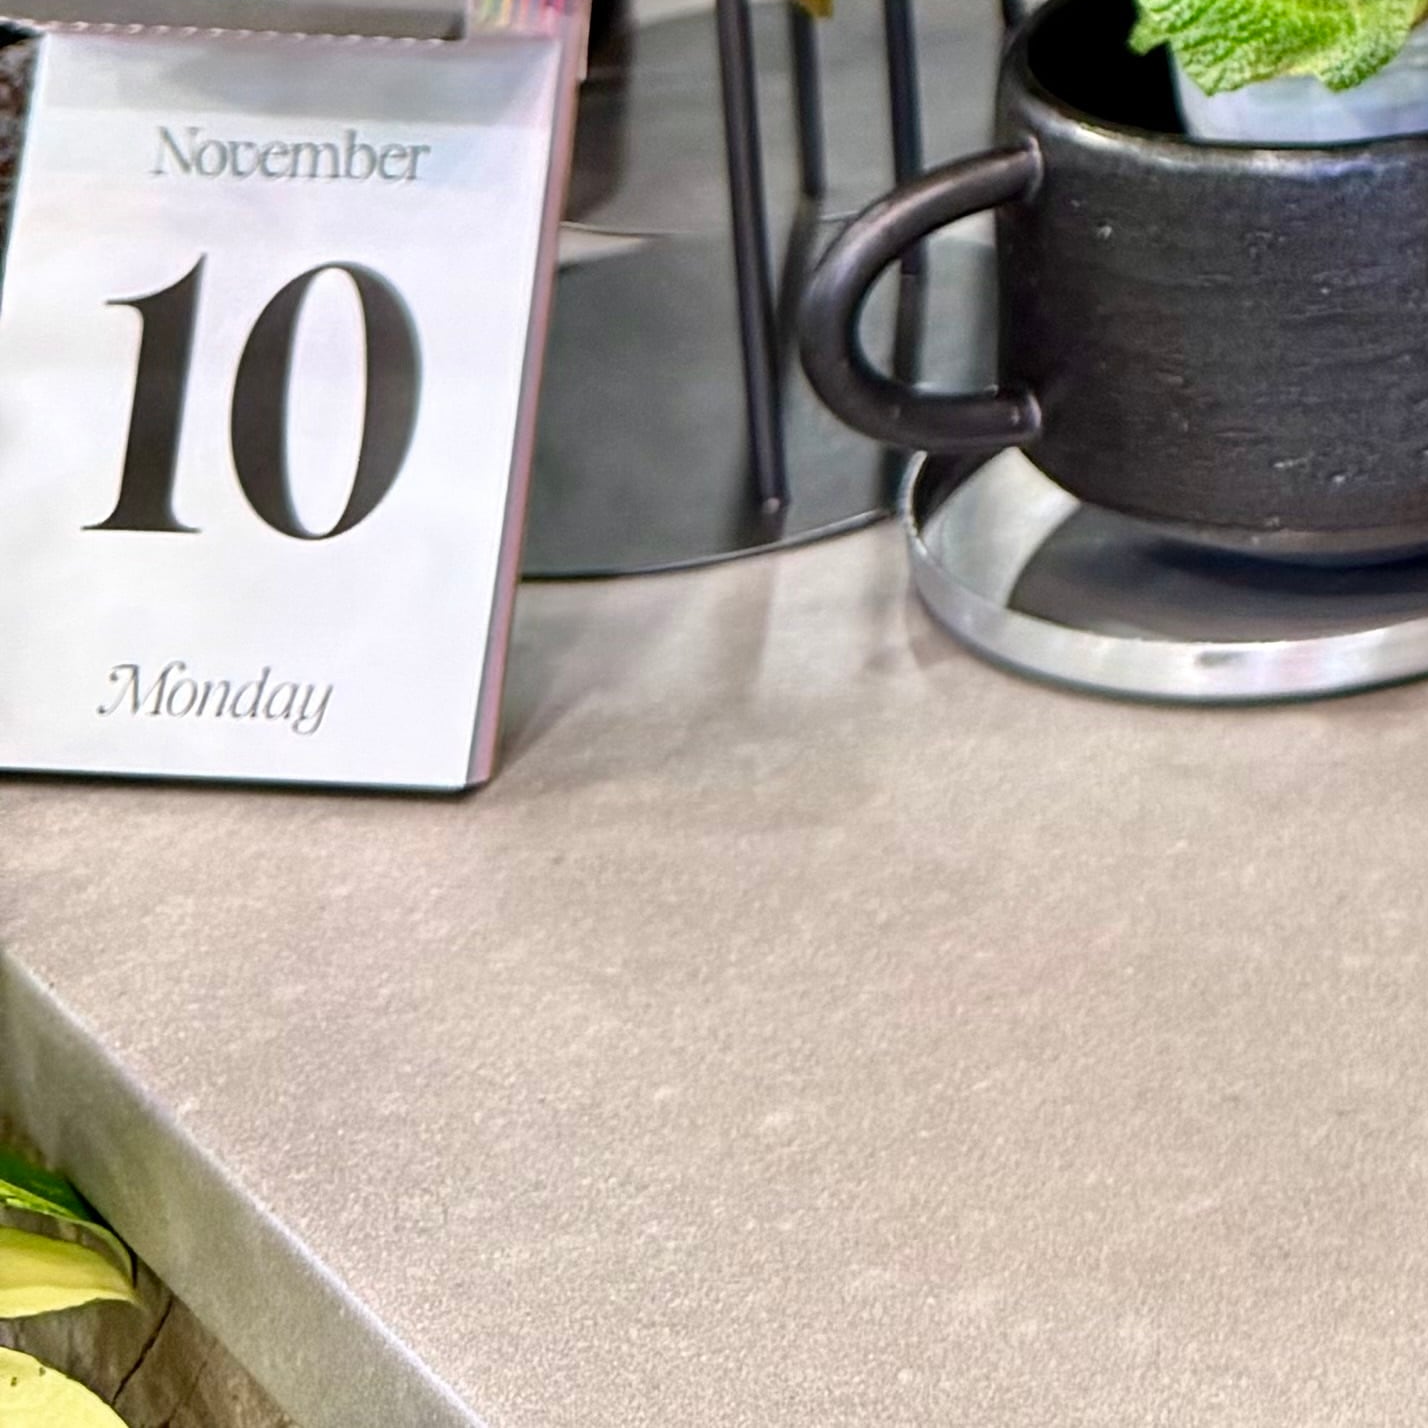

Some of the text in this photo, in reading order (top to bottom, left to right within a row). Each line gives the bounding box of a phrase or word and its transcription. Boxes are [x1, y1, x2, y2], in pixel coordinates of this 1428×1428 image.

[151, 126, 431, 182] November
[81, 252, 424, 541] 10
[99, 664, 333, 735] Monday
